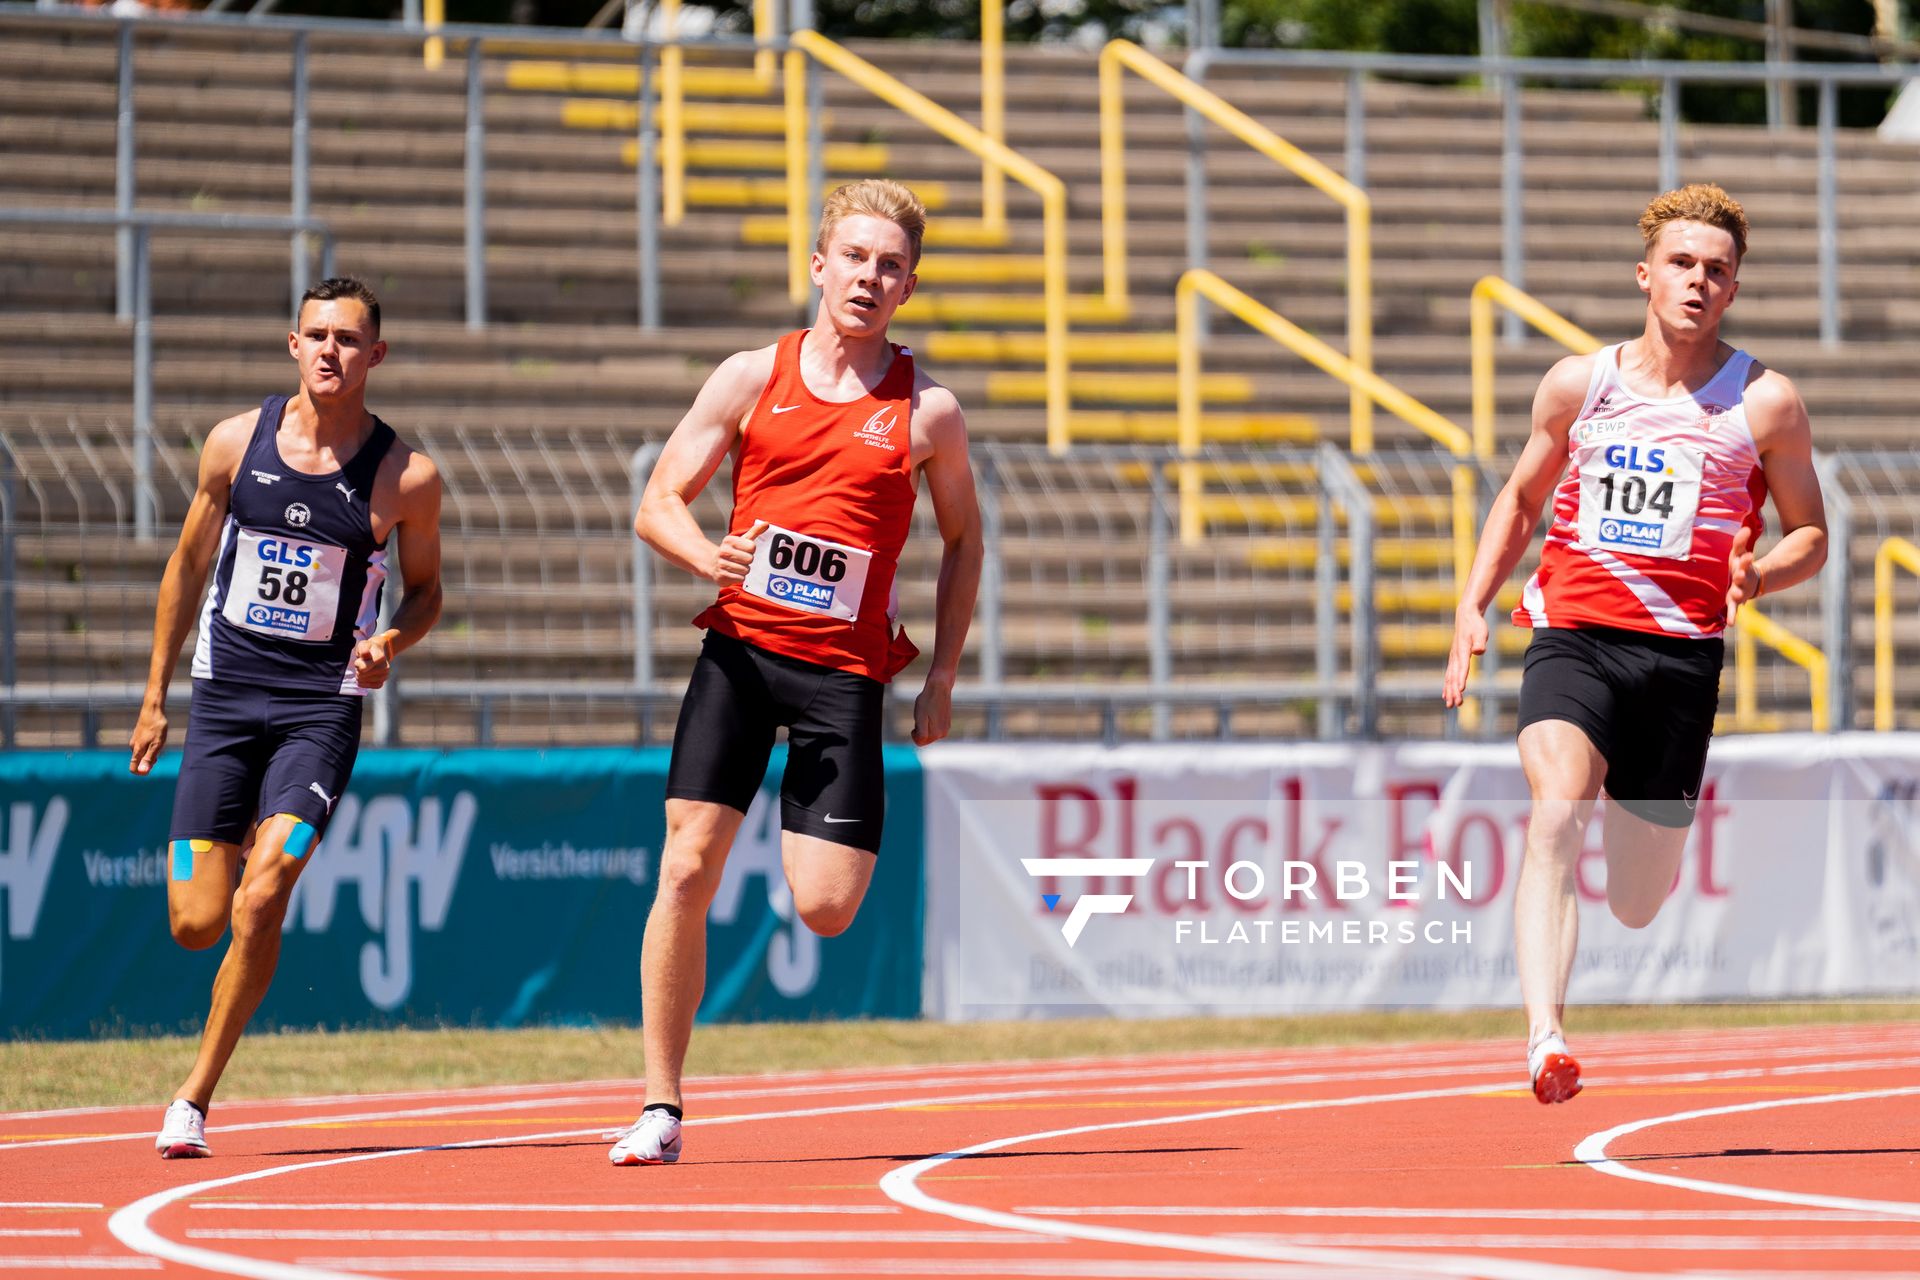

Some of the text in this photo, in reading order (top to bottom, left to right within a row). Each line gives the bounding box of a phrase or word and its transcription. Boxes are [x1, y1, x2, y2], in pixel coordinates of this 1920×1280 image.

[853, 431, 890, 443] SPORTHILFE
[1597, 421, 1625, 433] EWP
[1599, 473, 1674, 519] 104
[1622, 524, 1660, 540] PLAN
[769, 533, 848, 582] 606
[258, 565, 309, 606] 58
[794, 583, 832, 601] PLAN
[271, 610, 307, 626] PLAN
[1034, 776, 1734, 918] Black Foet
[490, 842, 647, 886] Versicherung
